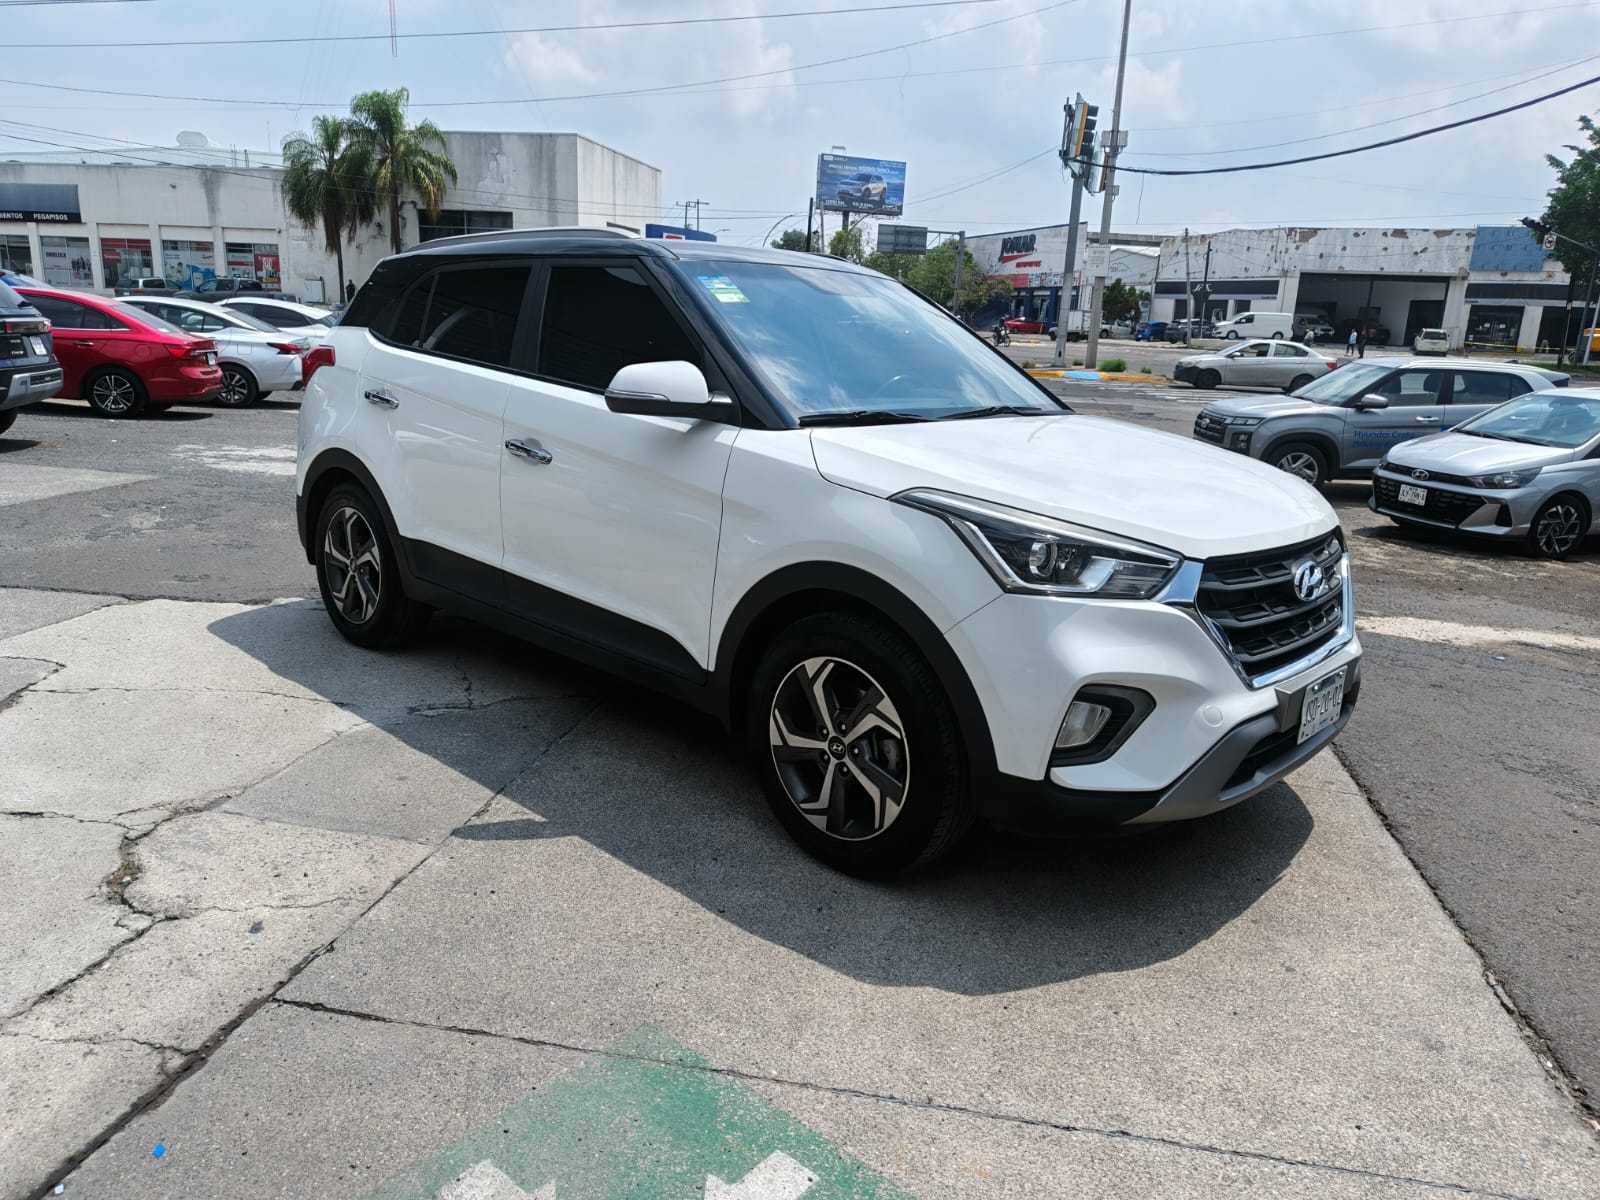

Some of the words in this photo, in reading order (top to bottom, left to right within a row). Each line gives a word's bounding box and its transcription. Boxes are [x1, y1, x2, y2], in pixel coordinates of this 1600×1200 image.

[33, 213, 68, 221] PEGAPISOS
[1354, 430, 1389, 440] Hyundai
[1391, 431, 1416, 440] Creta
